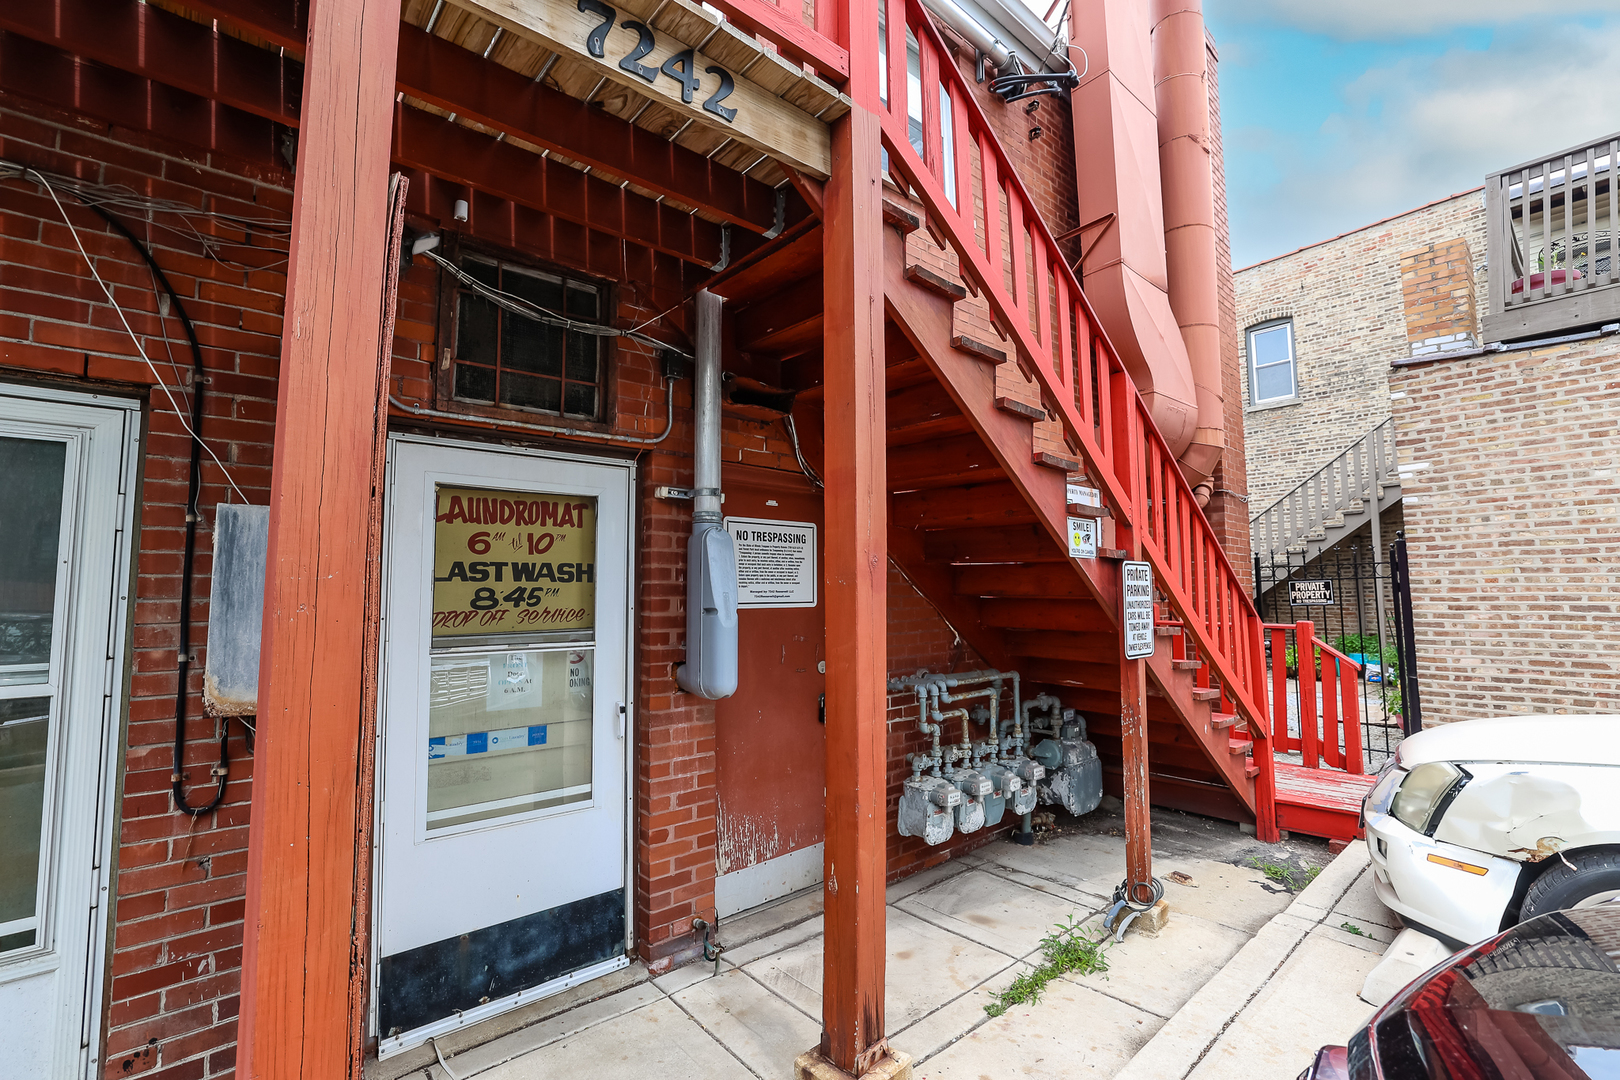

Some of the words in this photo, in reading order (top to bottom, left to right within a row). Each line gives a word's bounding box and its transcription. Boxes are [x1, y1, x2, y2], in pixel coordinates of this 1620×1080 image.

[578, 0, 738, 123] 7242
[436, 494, 589, 528] LAUNDROMAT
[1073, 522, 1091, 532] SMILE!
[736, 530, 749, 541] NO
[751, 531, 806, 544] TRESPASSING
[511, 562, 594, 583] WASH
[1127, 569, 1148, 581] PRIVATE
[1127, 585, 1149, 596] PARKING
[1295, 582, 1325, 591] PRIVATE
[470, 586, 543, 610] 8:45
[1291, 590, 1330, 599] PROPERTY
[433, 610, 479, 628] DROP
[480, 609, 510, 626] OFF
[570, 667, 579, 677] NO
[569, 677, 590, 687] OKING
